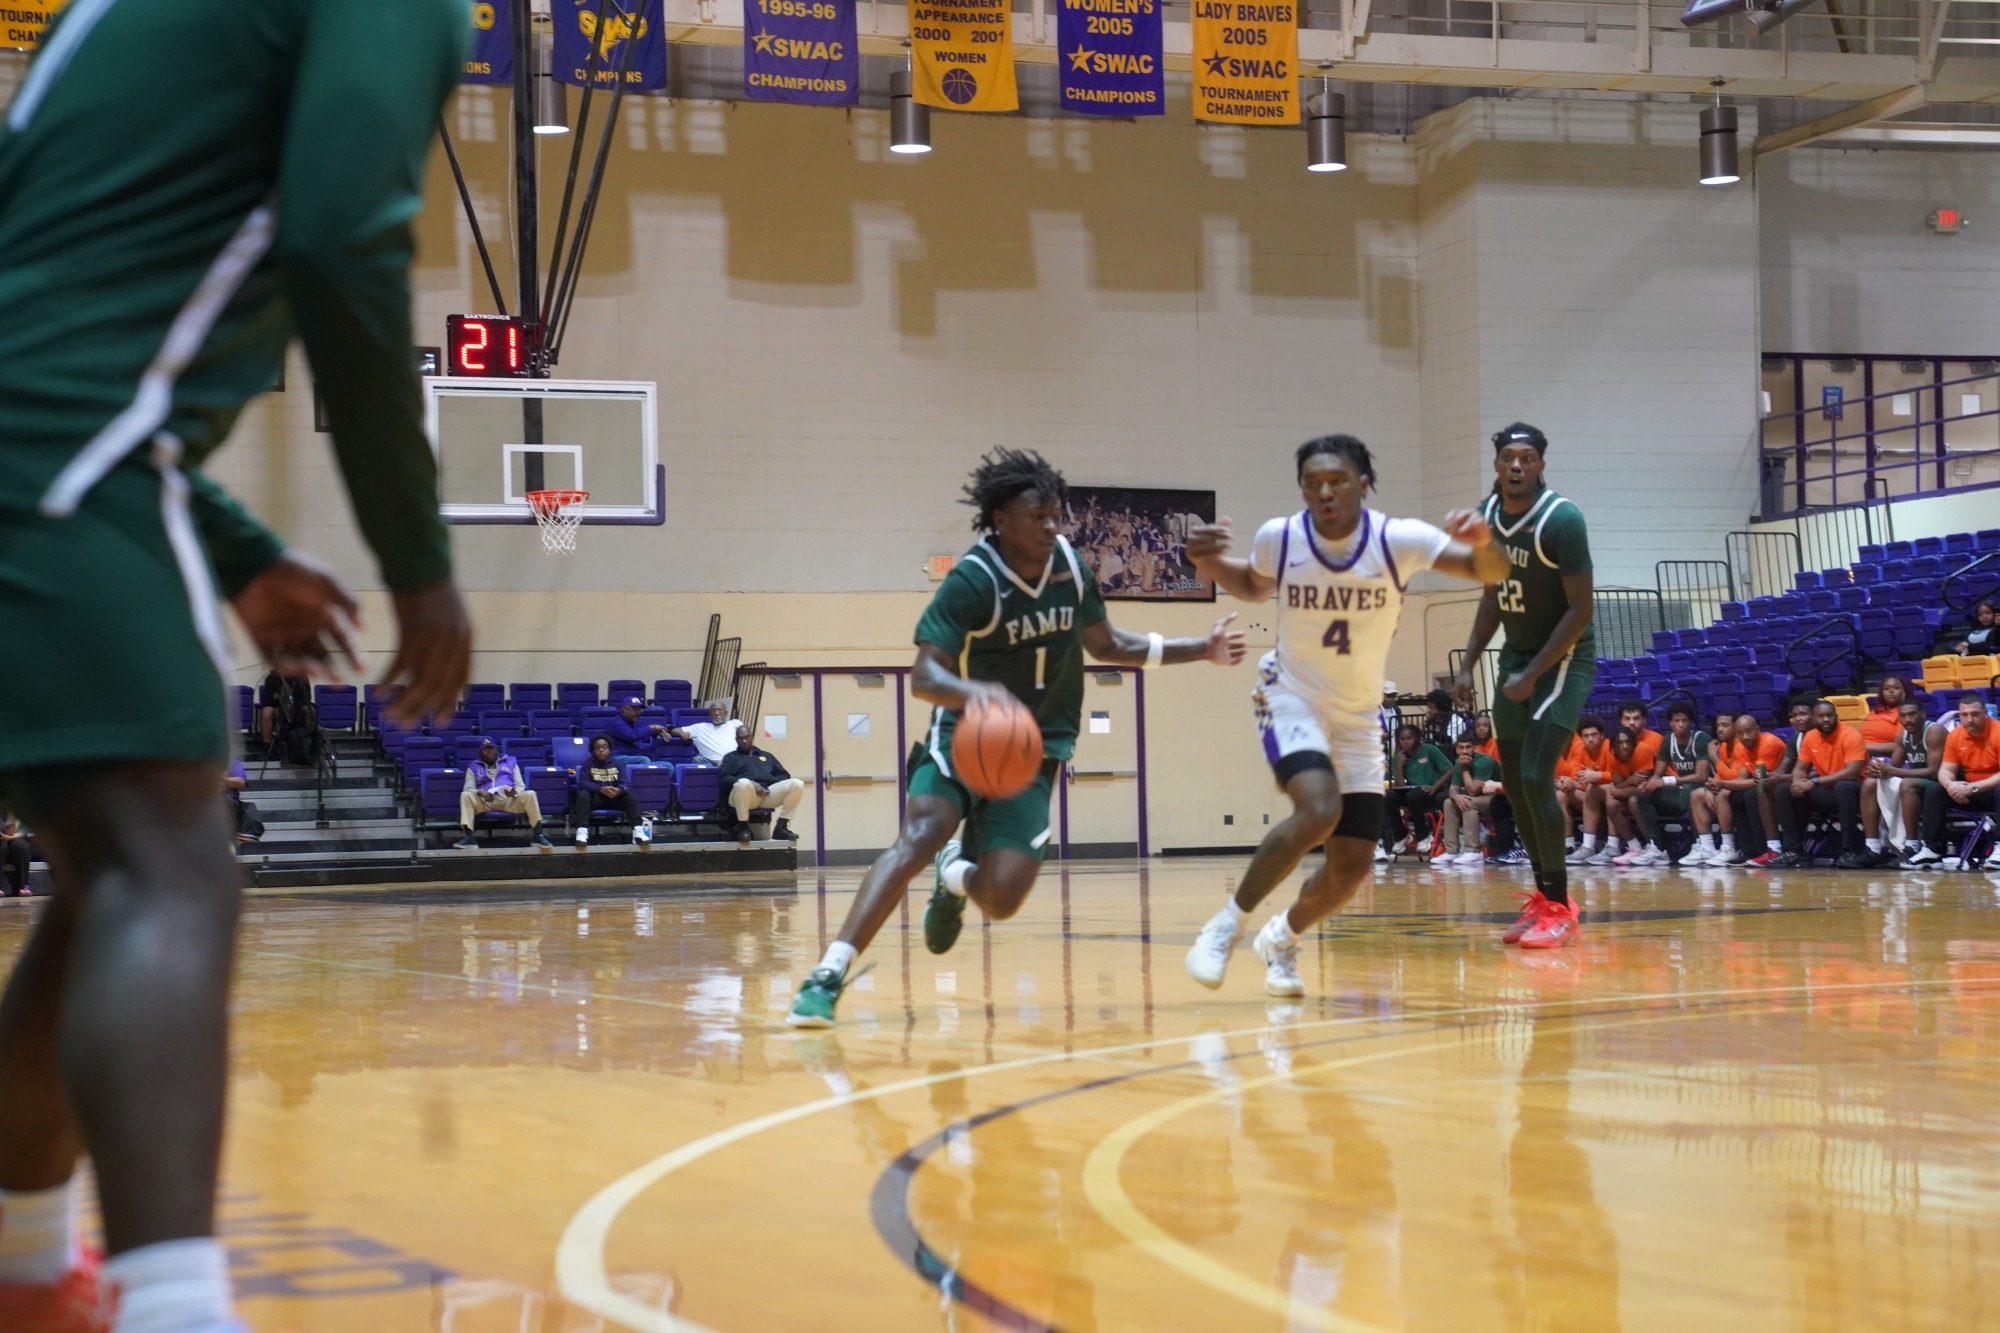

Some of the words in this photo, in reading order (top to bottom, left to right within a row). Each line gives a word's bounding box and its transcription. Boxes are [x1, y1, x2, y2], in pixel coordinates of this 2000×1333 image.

[758, 0, 836, 19] 1995-96
[914, 10, 1004, 23] APPEARANCE
[1195, 2, 1232, 20] LADY
[1237, 5, 1292, 22] BRAVES
[913, 27, 951, 41] 2000
[971, 30, 1004, 43] 2001
[1086, 16, 1133, 35] 2005
[1222, 27, 1268, 45] 2005
[773, 38, 844, 61] SWAC
[934, 51, 987, 63] WOMEN
[1092, 53, 1154, 74] SWAC
[1229, 59, 1287, 79] SWAC
[574, 68, 643, 83] CHMPINS
[748, 73, 847, 92] CHAMPIONS
[1065, 87, 1156, 103] CHAMPIONS
[1200, 86, 1290, 102] TOURNAMENT
[1206, 102, 1284, 118] CHAMPIONS
[461, 323, 517, 370] 21
[1287, 583, 1388, 612] BRAVES
[1496, 579, 1526, 613] 22
[1005, 606, 1074, 645] FAMU
[1322, 619, 1352, 655] 4
[1035, 647, 1047, 690] 1
